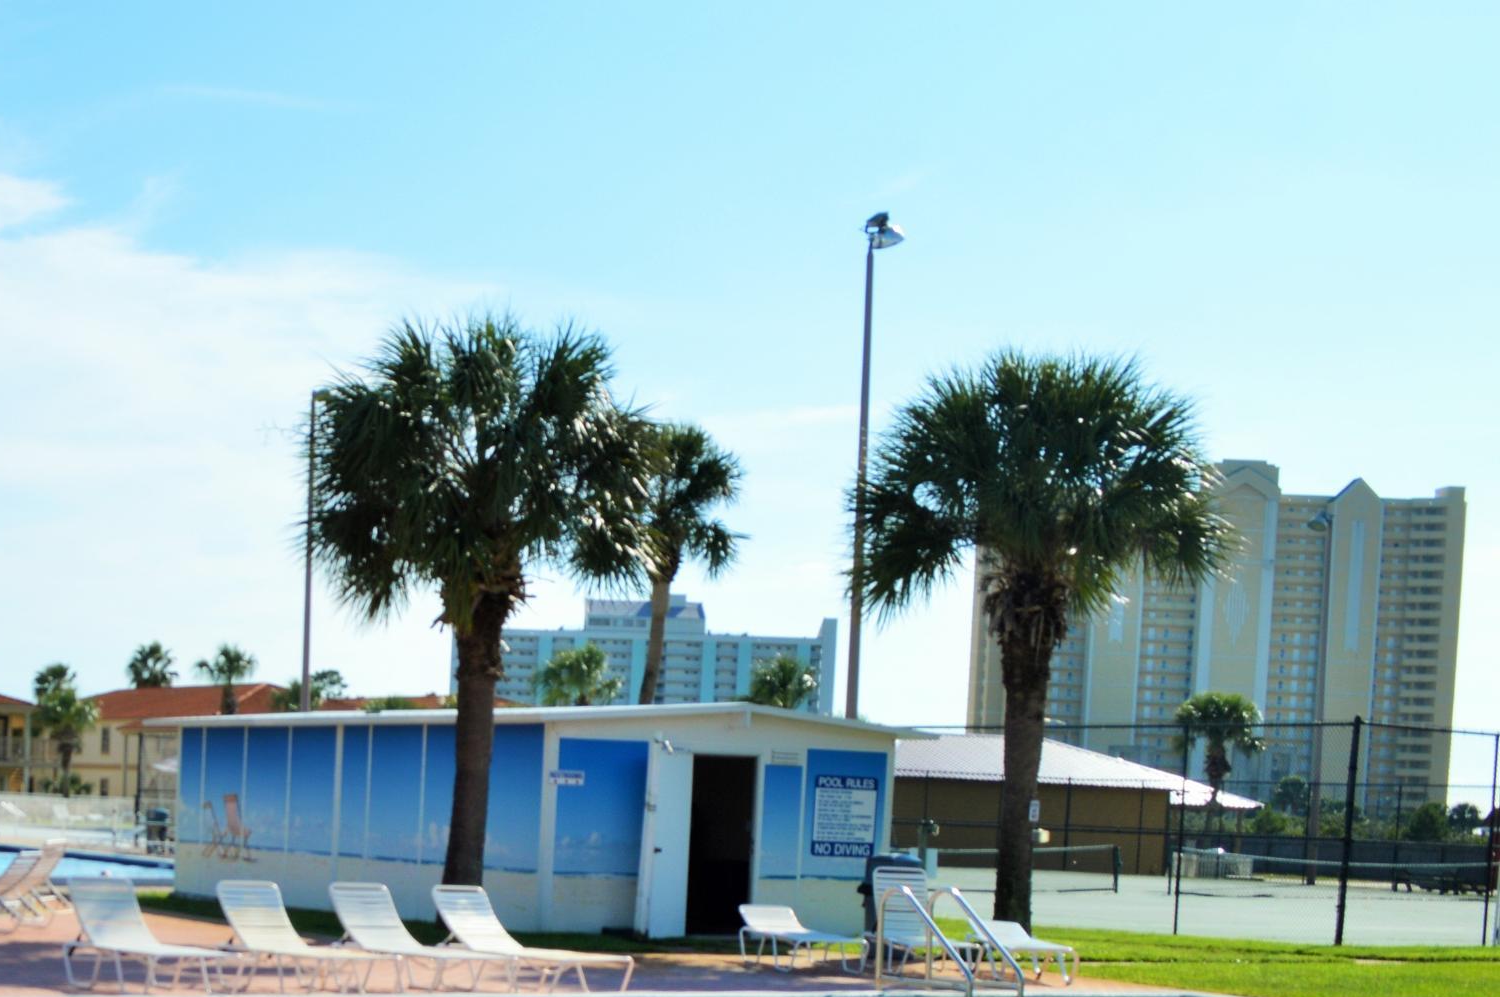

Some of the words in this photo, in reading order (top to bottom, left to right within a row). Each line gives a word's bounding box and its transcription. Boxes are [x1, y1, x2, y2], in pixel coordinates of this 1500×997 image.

[818, 776, 844, 787] POOL
[845, 778, 875, 789] RULES
[814, 843, 831, 854] NO
[834, 844, 870, 856] DIVING
